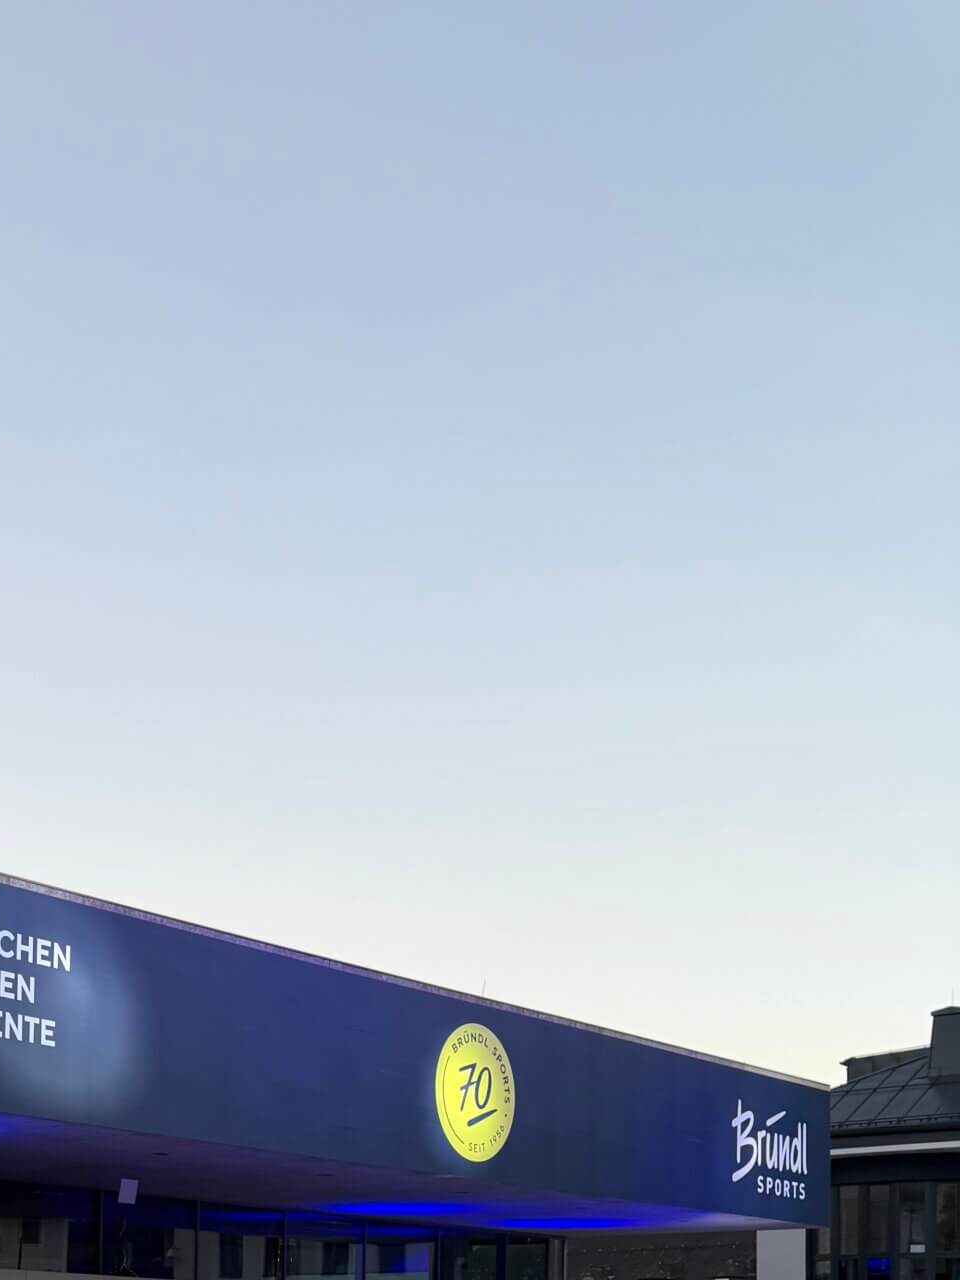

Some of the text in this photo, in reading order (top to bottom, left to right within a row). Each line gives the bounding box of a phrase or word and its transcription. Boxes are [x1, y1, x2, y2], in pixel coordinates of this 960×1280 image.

[451, 1031, 510, 1105] BRÜNDL SPORTS
[459, 1062, 492, 1112] 70
[468, 1142, 486, 1153] SEIT
[757, 1175, 806, 1200] SPORTS
